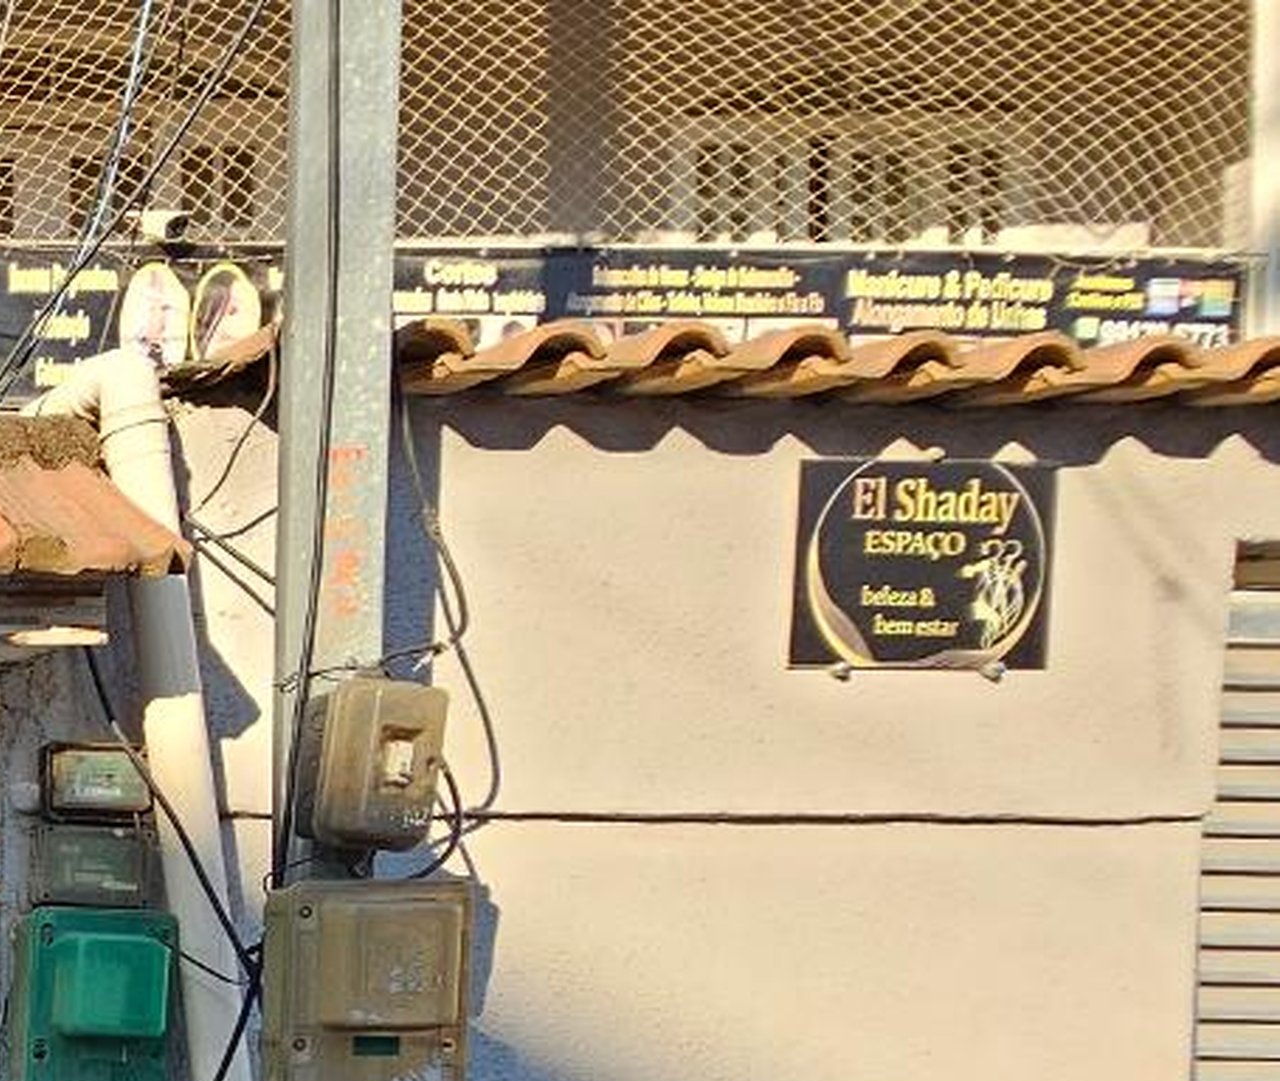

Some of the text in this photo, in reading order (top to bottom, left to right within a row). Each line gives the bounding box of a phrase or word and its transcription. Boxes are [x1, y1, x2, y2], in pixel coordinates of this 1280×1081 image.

[852, 477, 1020, 534] El Shaday
[864, 531, 966, 561] ESPAÇO
[861, 586, 935, 606] beleza &
[873, 614, 959, 636] bem estar
